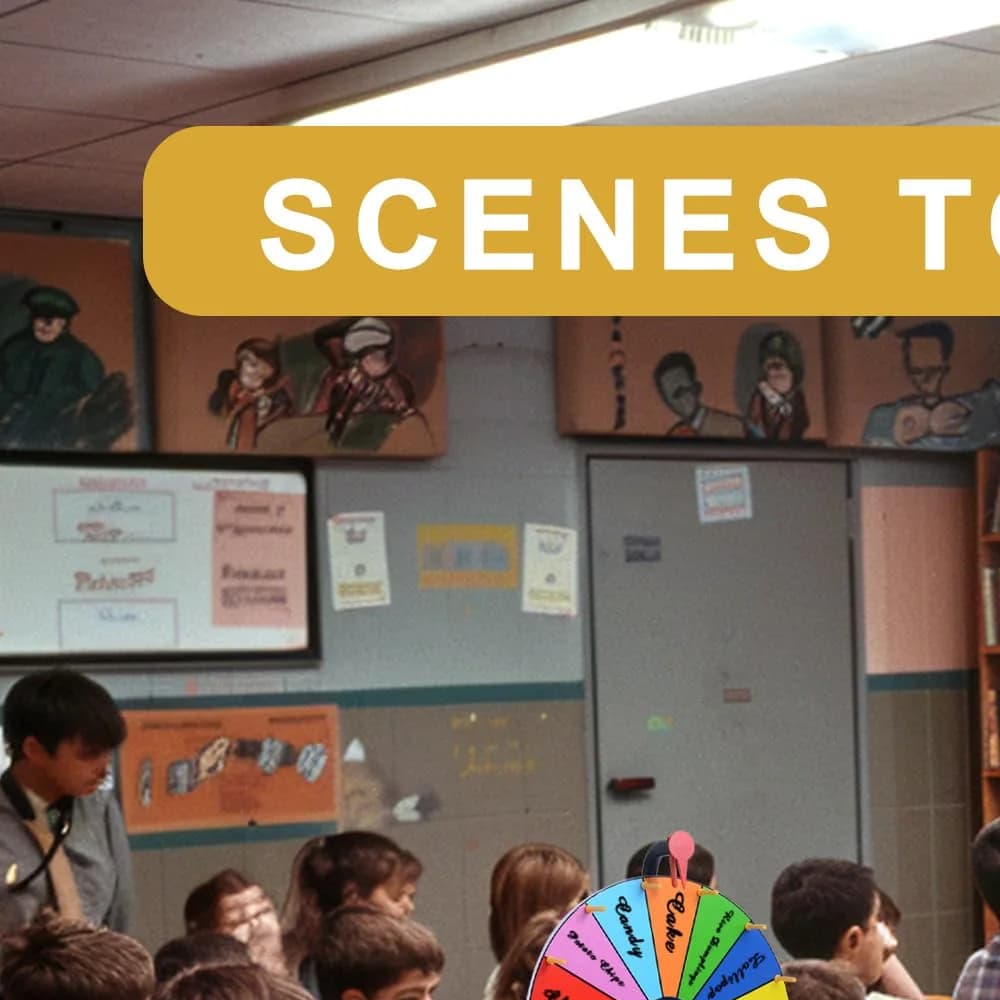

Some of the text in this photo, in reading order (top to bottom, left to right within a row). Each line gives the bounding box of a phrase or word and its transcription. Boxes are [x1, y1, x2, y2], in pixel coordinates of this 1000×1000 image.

[615, 895, 645, 958] Candy
[665, 891, 685, 954] Cake
[599, 959, 625, 987] Chips
[707, 952, 766, 1000] Lollipop
